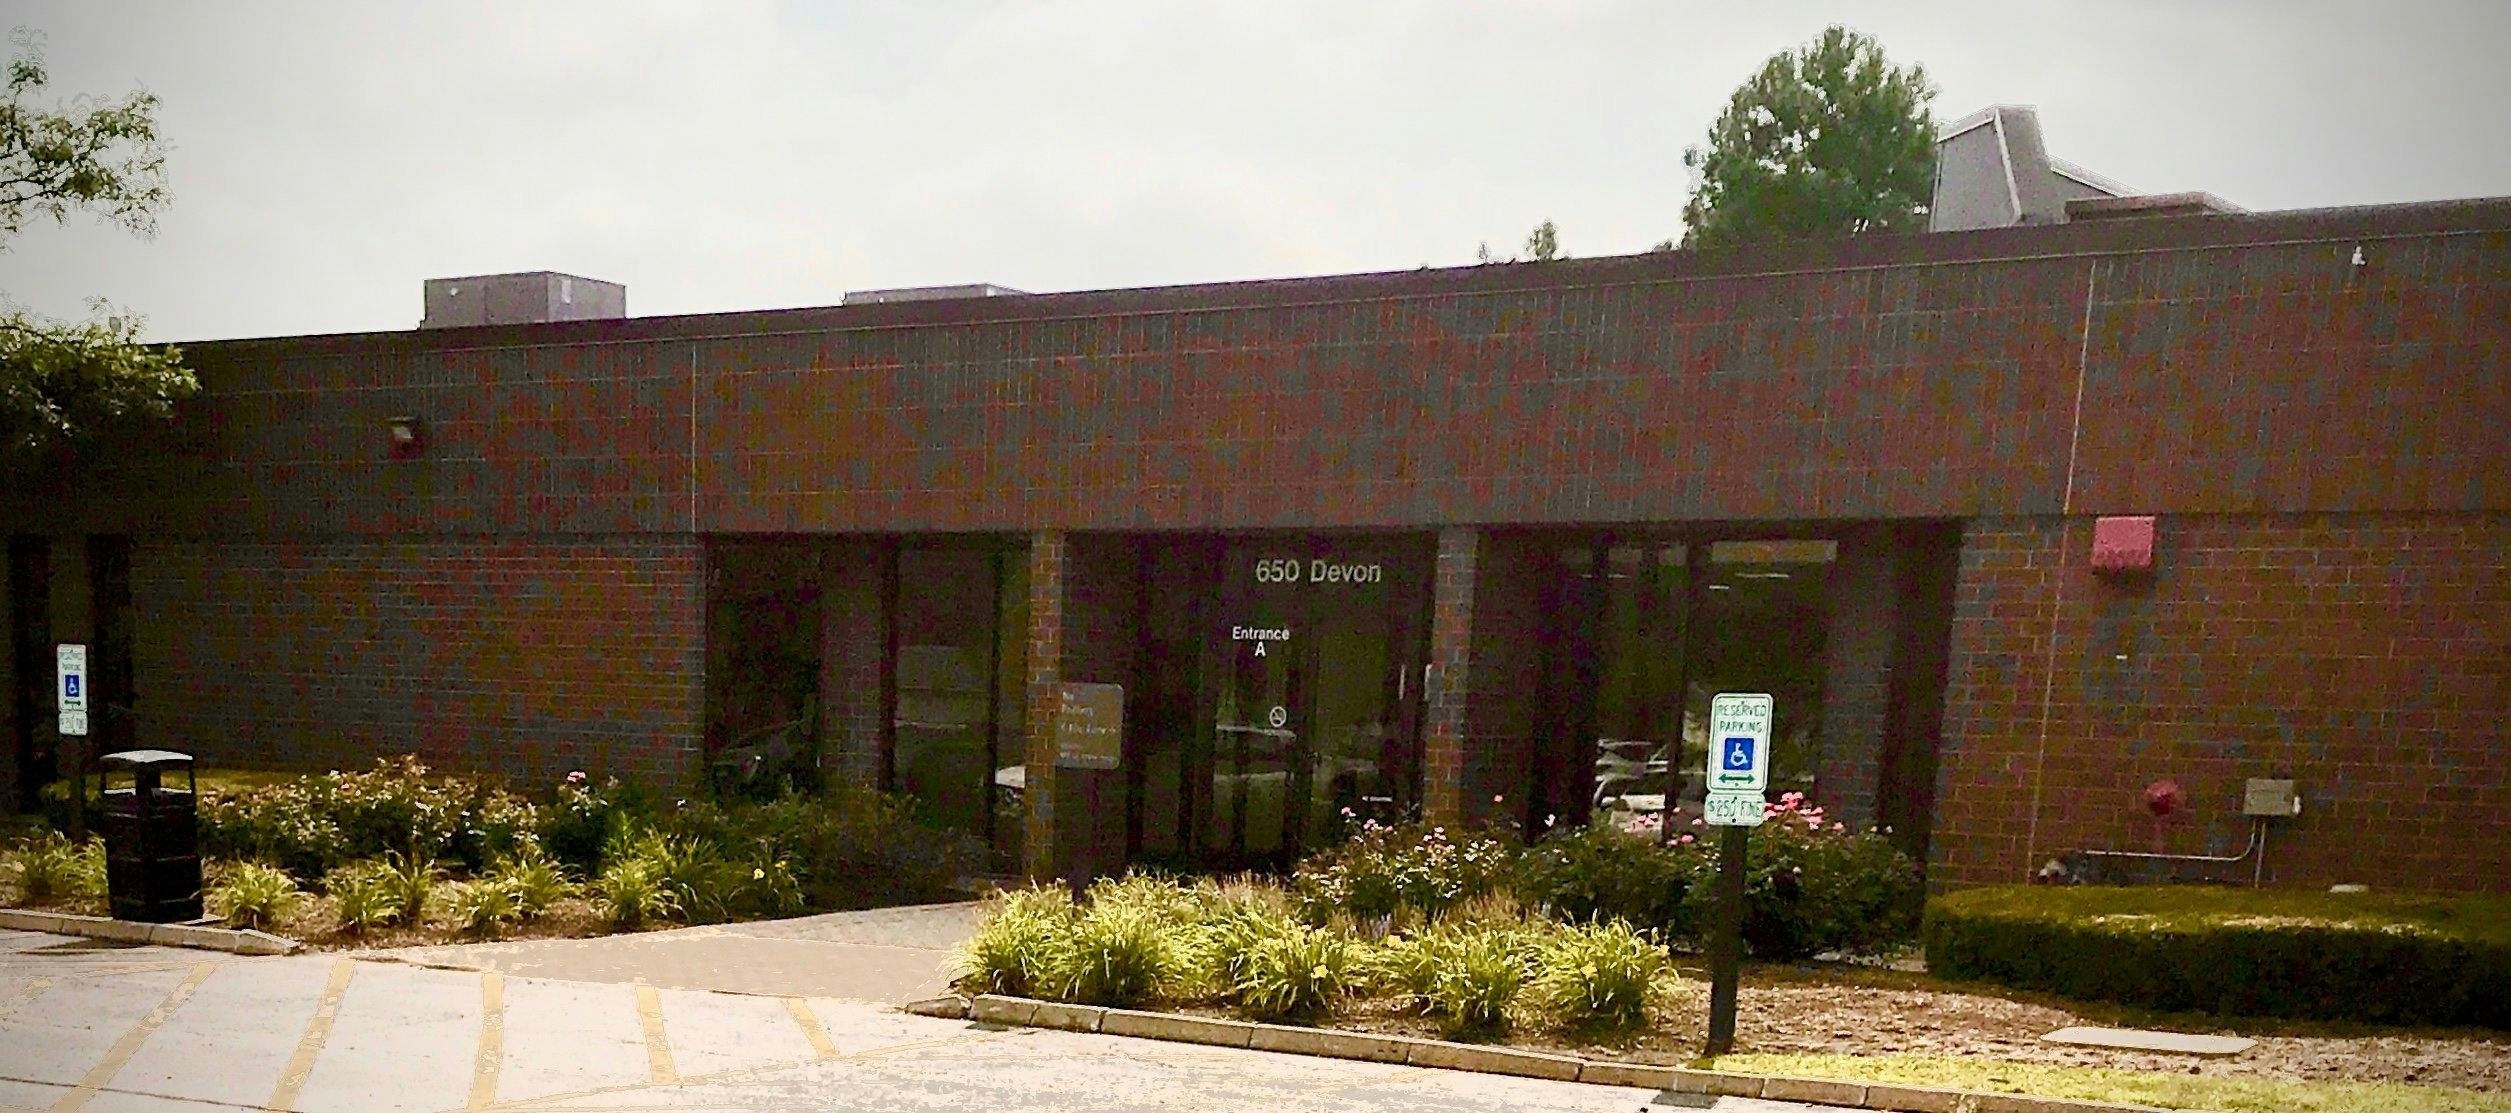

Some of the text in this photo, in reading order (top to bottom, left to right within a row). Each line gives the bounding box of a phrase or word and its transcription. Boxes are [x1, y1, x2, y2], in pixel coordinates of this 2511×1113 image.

[1255, 559, 1382, 583] 650 Devon
[1232, 626, 1290, 641] Entrance
[1254, 641, 1266, 657] A
[1716, 704, 1767, 717] RESERVED
